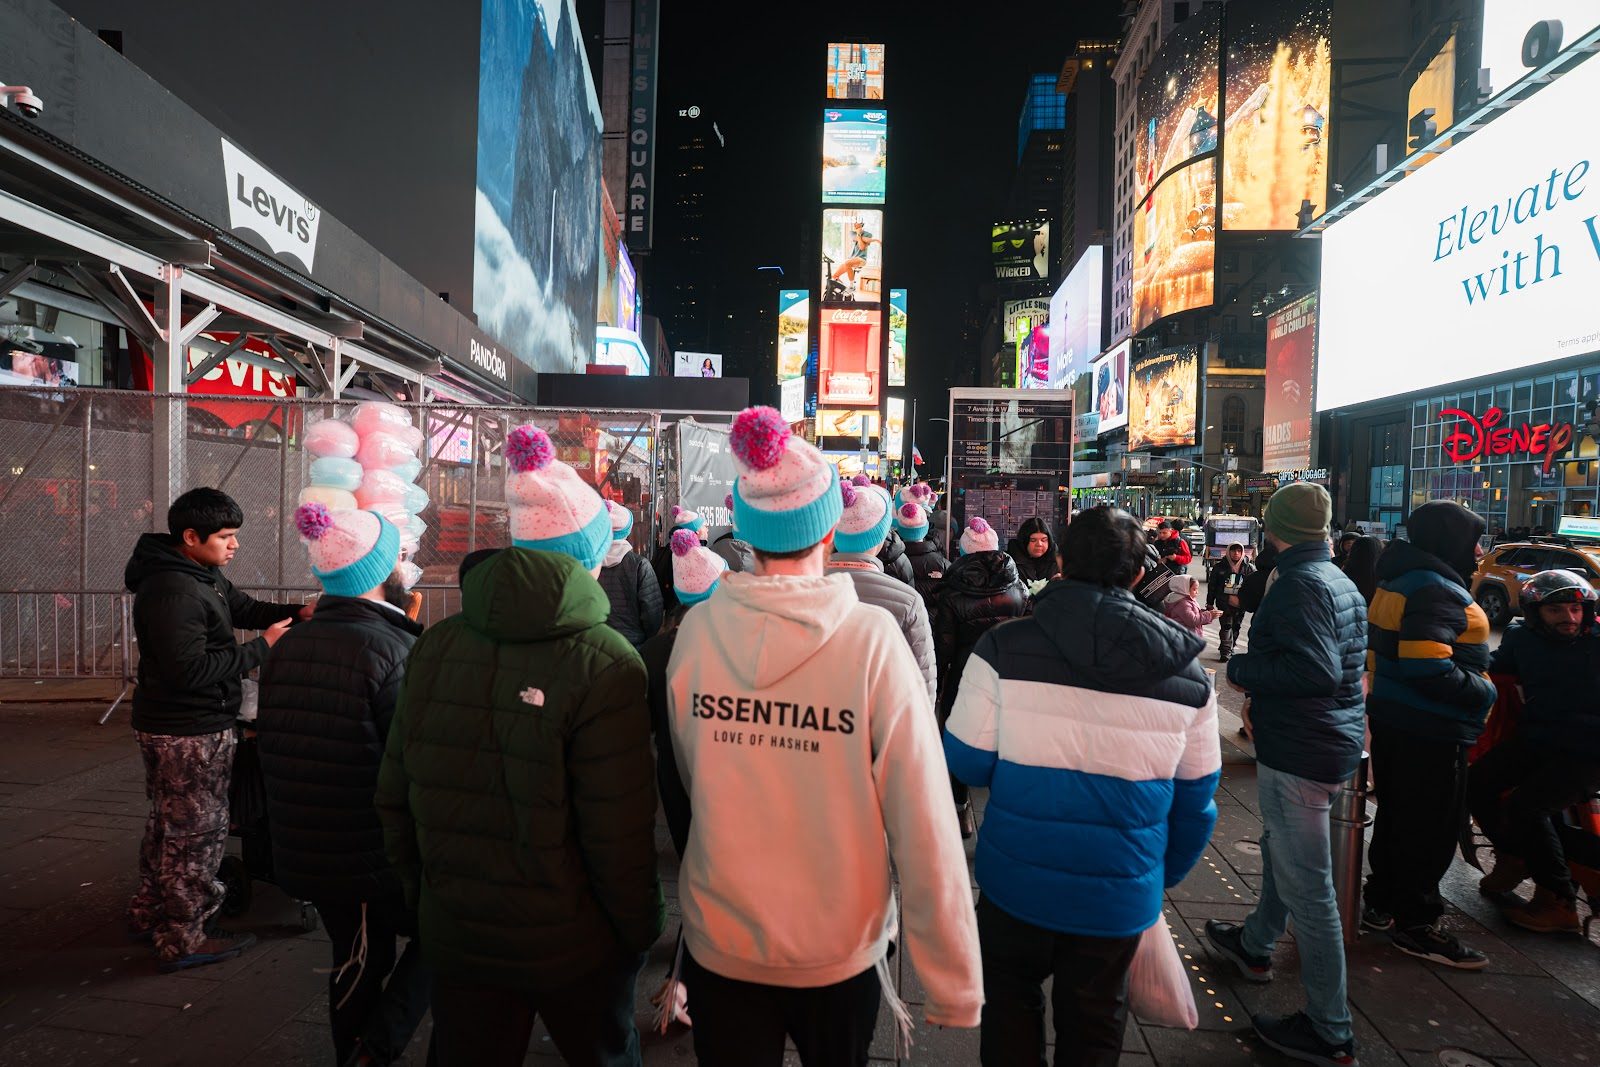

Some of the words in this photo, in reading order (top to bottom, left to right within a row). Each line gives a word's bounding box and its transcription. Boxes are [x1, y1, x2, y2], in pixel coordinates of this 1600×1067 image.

[634, 0, 652, 91] IMES
[630, 107, 650, 232] SQUARE
[1433, 160, 1589, 262] Elevate
[1462, 234, 1562, 306] with
[1010, 301, 1032, 315] LITTLE
[1557, 336, 1580, 348] Terms
[1581, 331, 1600, 344] appl
[1278, 471, 1294, 481] GIFTS
[1298, 468, 1327, 480] LUGGAGE
[693, 693, 855, 735] ESSENTIALS
[714, 730, 744, 745] LOVE
[749, 734, 765, 747] OF
[770, 735, 820, 753] HASHEM
